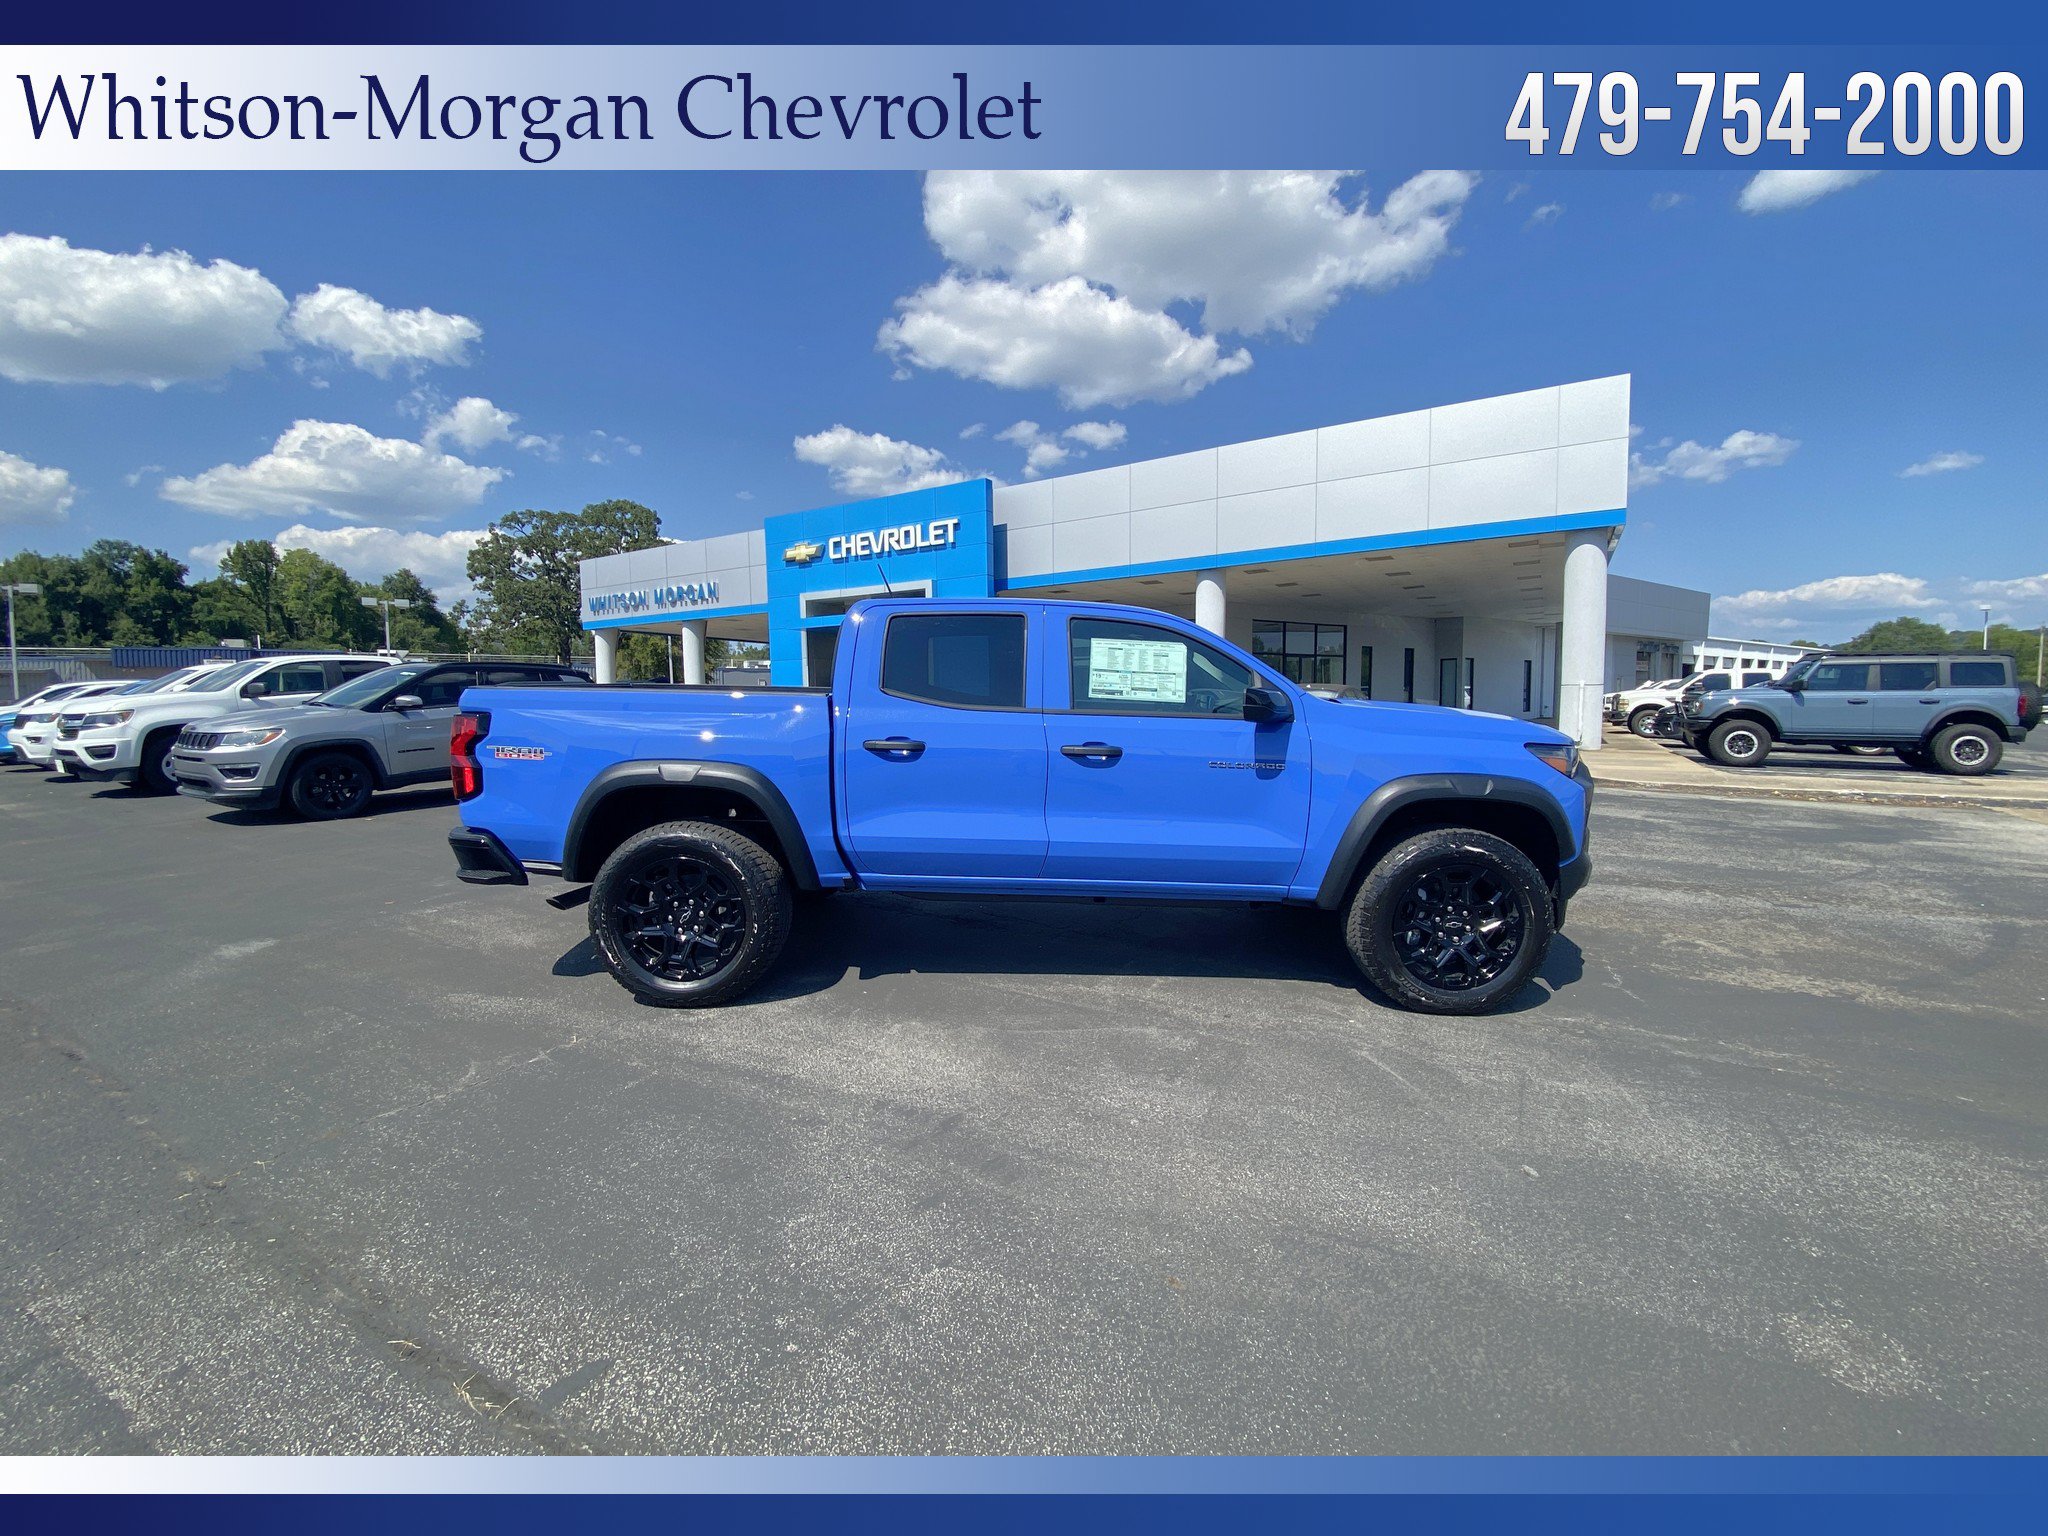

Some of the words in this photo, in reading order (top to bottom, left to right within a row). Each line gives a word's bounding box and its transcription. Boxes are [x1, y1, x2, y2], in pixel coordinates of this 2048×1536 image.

[828, 518, 959, 560] CHEVROLET
[588, 591, 649, 612] WHITSON
[654, 580, 719, 606] MORGAN
[1208, 761, 1286, 770] COLORADO
